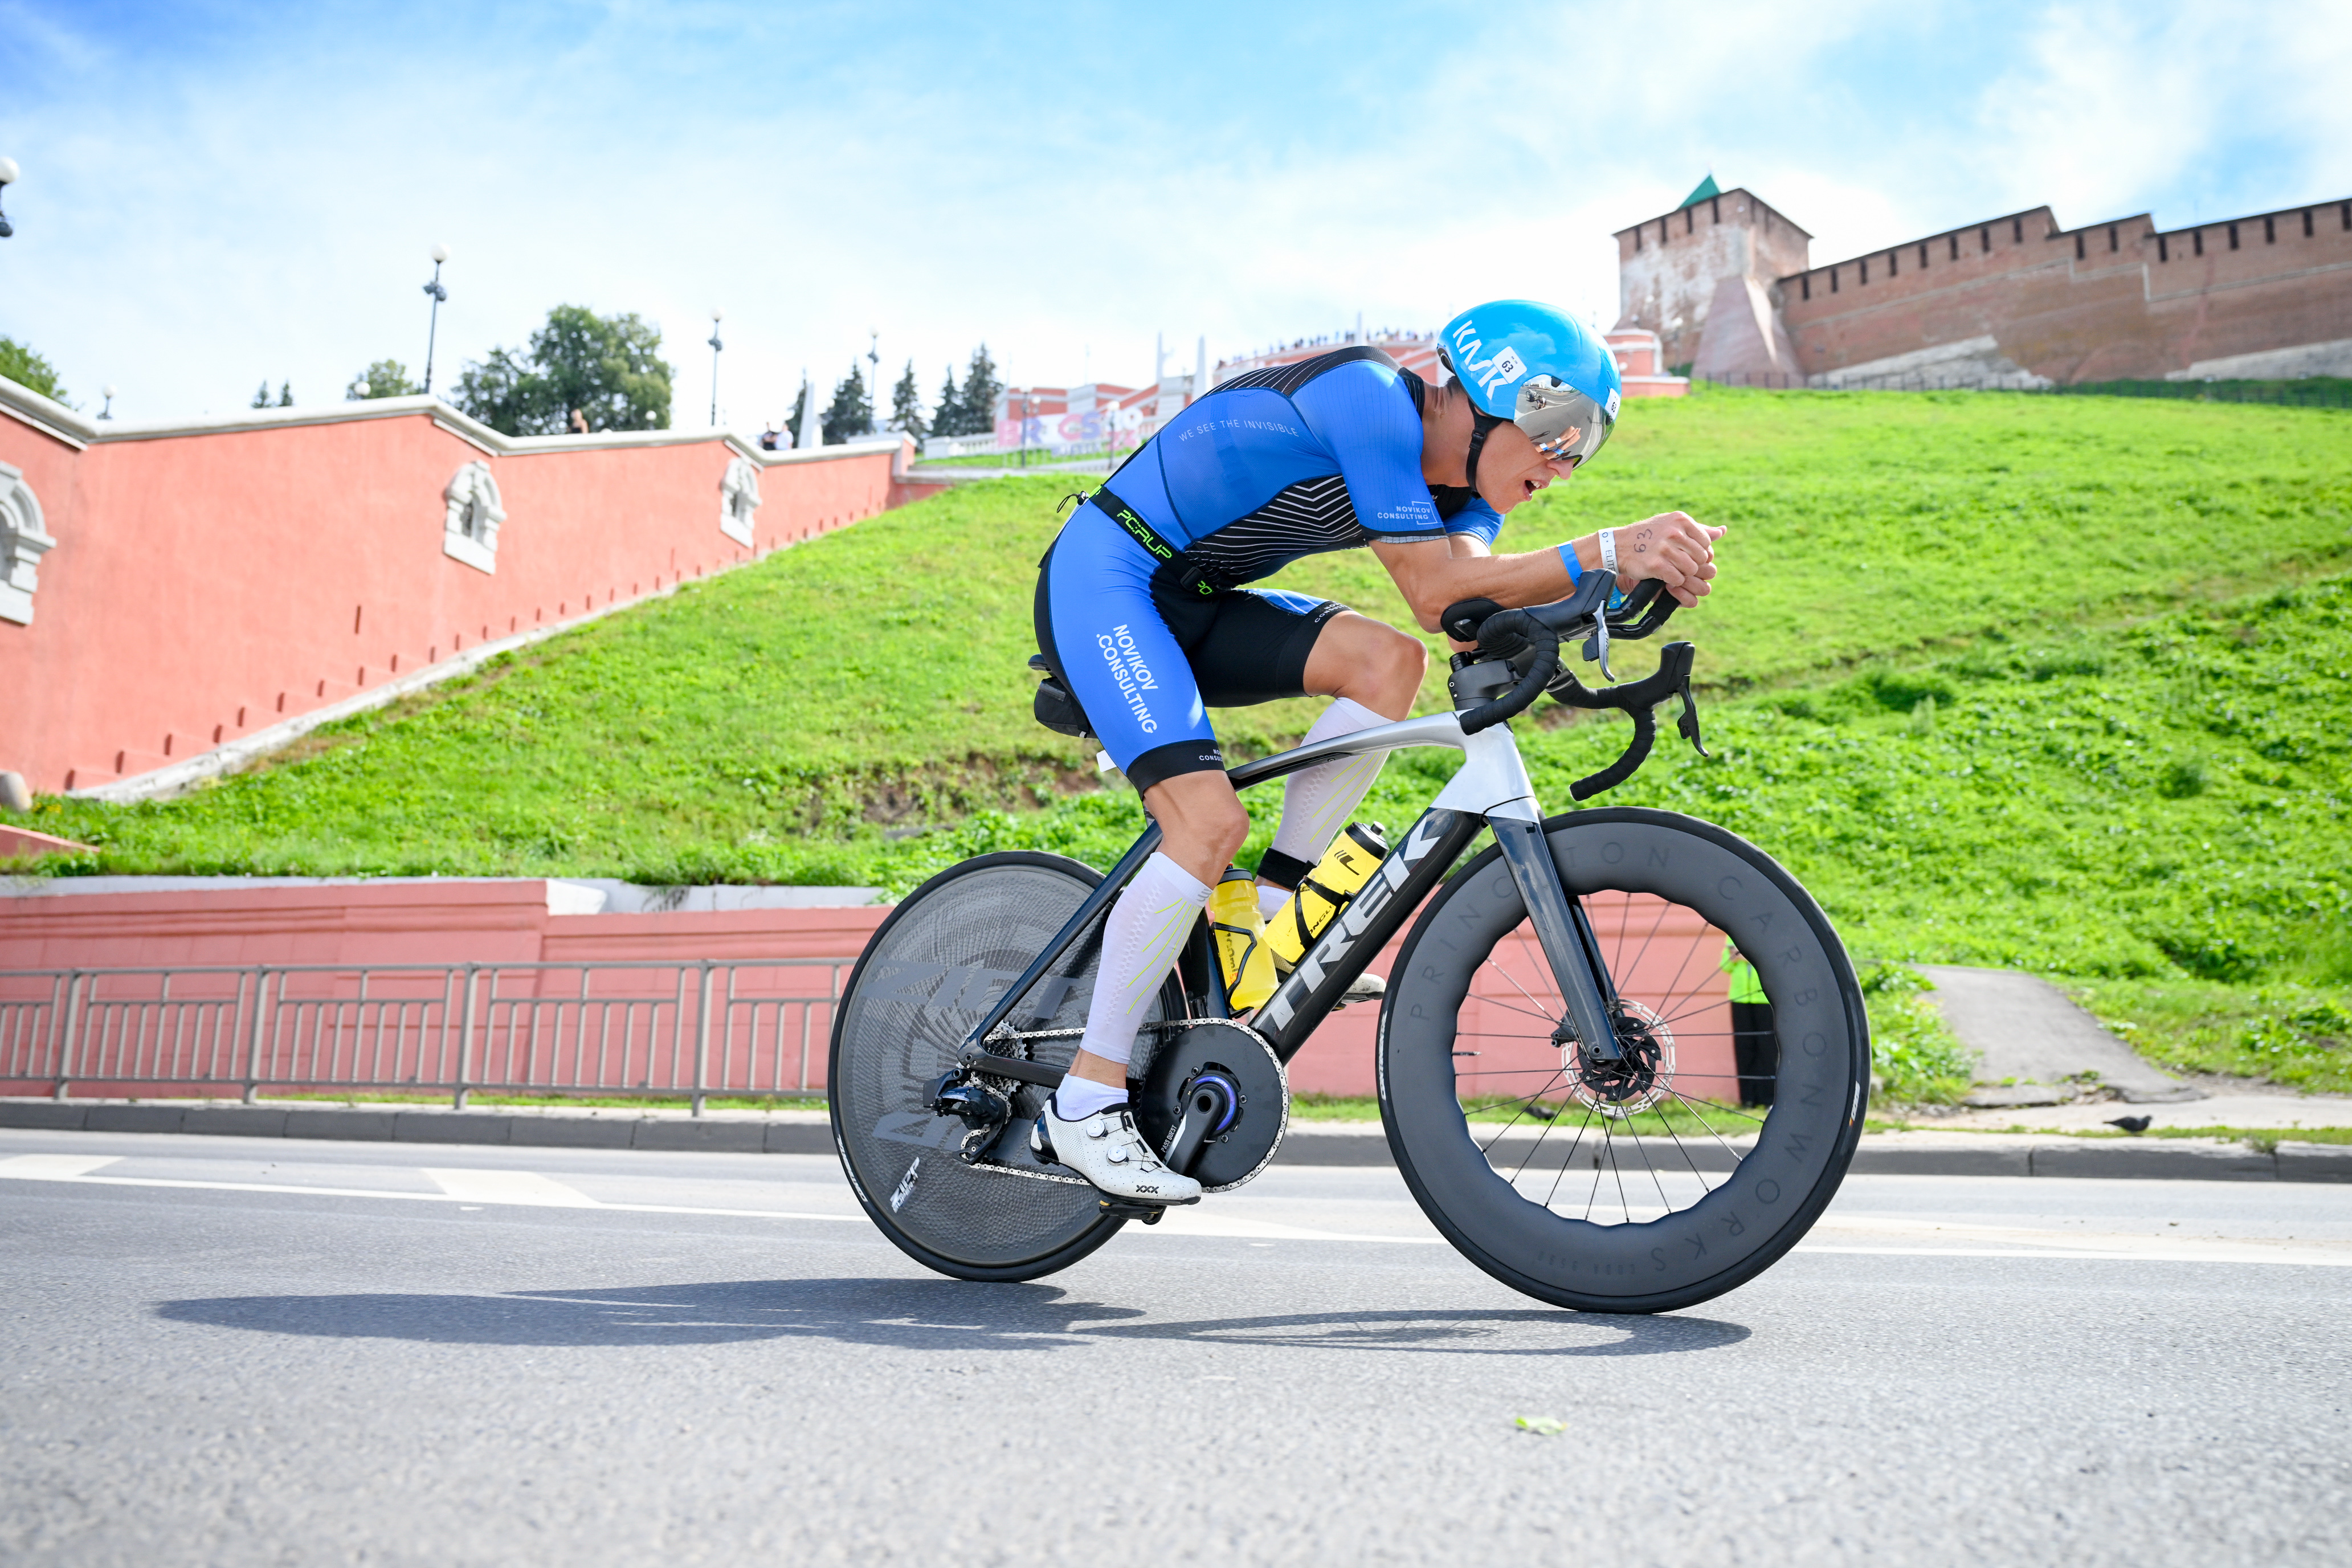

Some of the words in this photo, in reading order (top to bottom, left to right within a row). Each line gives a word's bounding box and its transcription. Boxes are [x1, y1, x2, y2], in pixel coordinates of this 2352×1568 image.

[1452, 320, 1509, 401] KASK
[1501, 360, 1514, 373] 63
[1611, 401, 1617, 413] 63
[1178, 430, 1194, 442] WE
[1197, 422, 1216, 434] SEE
[1219, 419, 1240, 428] THE
[1244, 420, 1300, 437] INVISIBLE
[1633, 528, 1652, 553] 63
[1113, 624, 1159, 691] NOVIKOV
[1255, 815, 1441, 1031] TREK
[1410, 842, 1671, 1020] PRINCTON
[1161, 1139, 1170, 1153] PASS
[1166, 1124, 1177, 1140] QUEST
[889, 1156, 920, 1206] ZIPP
